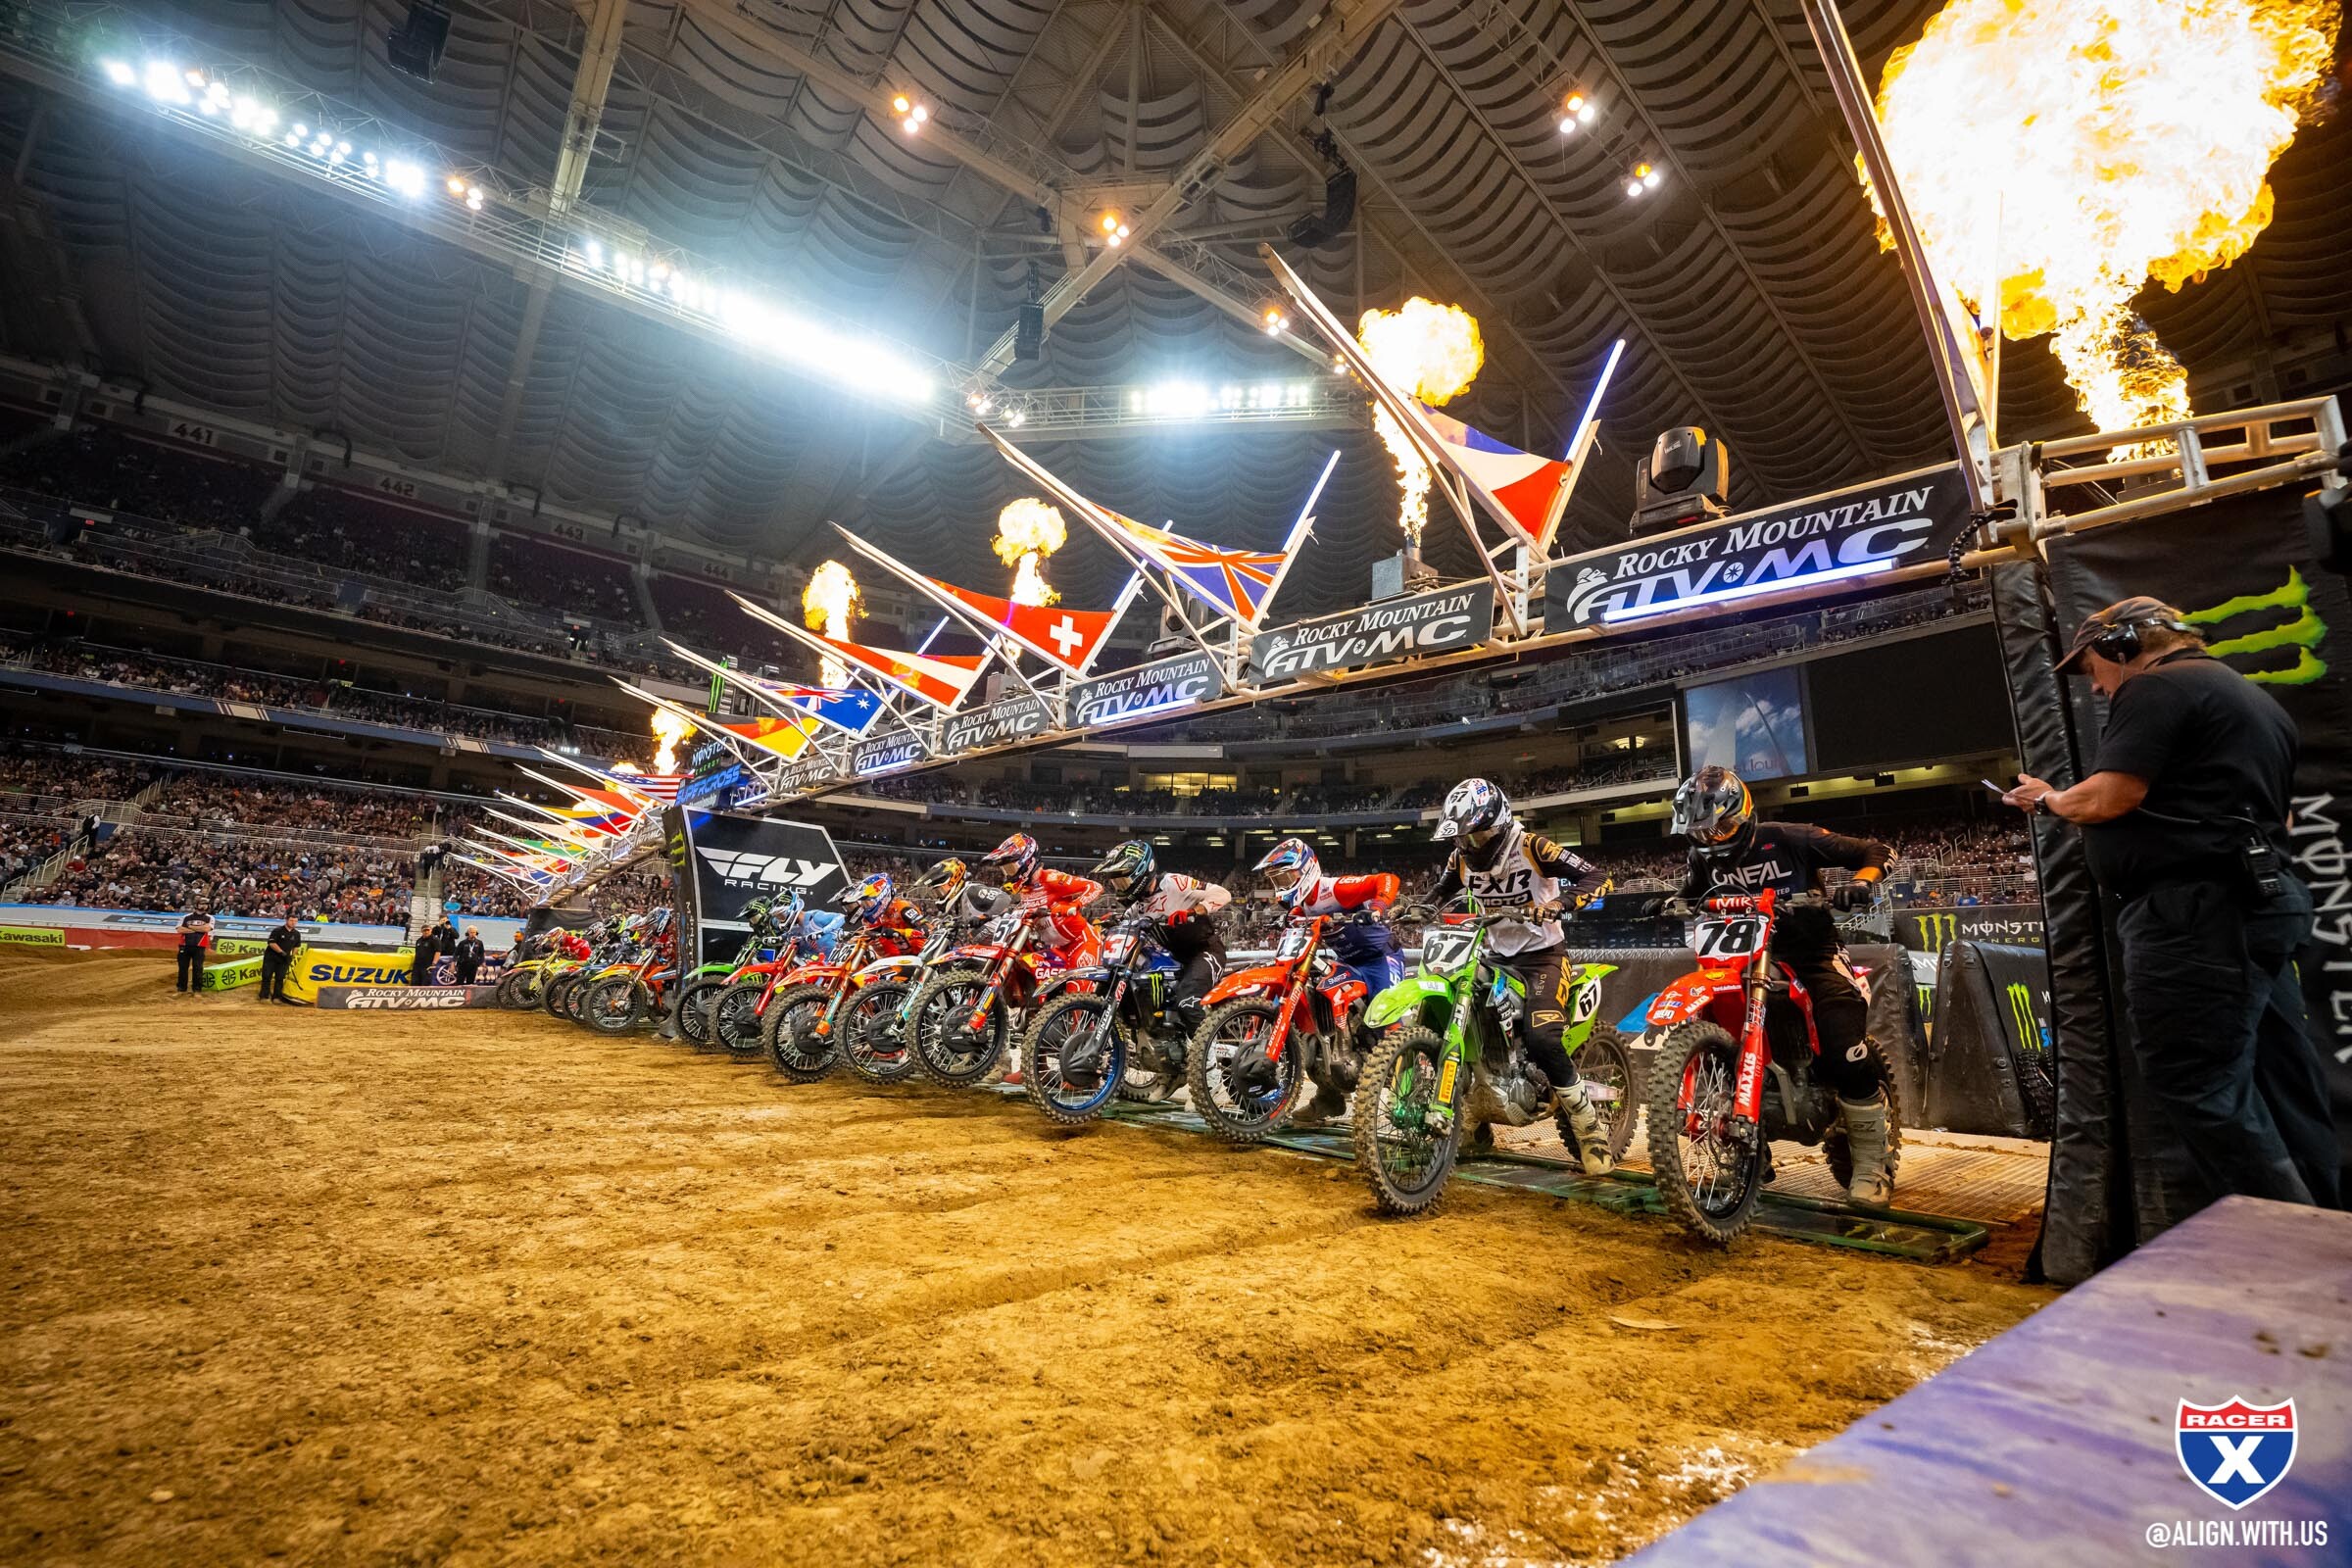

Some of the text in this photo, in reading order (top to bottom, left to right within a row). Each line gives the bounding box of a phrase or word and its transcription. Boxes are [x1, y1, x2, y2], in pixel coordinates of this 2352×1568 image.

[174, 423, 214, 444] 441
[379, 477, 415, 497] 442
[554, 523, 583, 539] 443
[1613, 486, 1935, 580] ROCKY MOUNTAIN
[703, 563, 729, 578] 444
[1292, 592, 1476, 647] ROCKY MOUNTAIN
[1095, 658, 1209, 698] ROCKY MOUNTAIN
[960, 698, 1041, 729] ROCKY MOUNTAIN
[864, 740, 885, 755] ROCKY
[674, 763, 742, 807] SUPERCROSS
[696, 846, 840, 887] FLY
[724, 878, 808, 896] RACING
[1469, 868, 1532, 895] FXR
[994, 920, 1017, 943] 51
[1698, 919, 1761, 956] 78
[1103, 934, 1134, 959] 3
[1423, 933, 1474, 963] 67
[309, 964, 412, 985] SUZUK
[1536, 973, 1547, 996] REVO
[366, 988, 404, 997] ROCKY
[406, 988, 466, 998] MOUNTAIN
[1579, 983, 1597, 1017] 67
[1268, 1011, 1283, 1046] DUNLOP
[1739, 1052, 1757, 1107] MAXXIS
